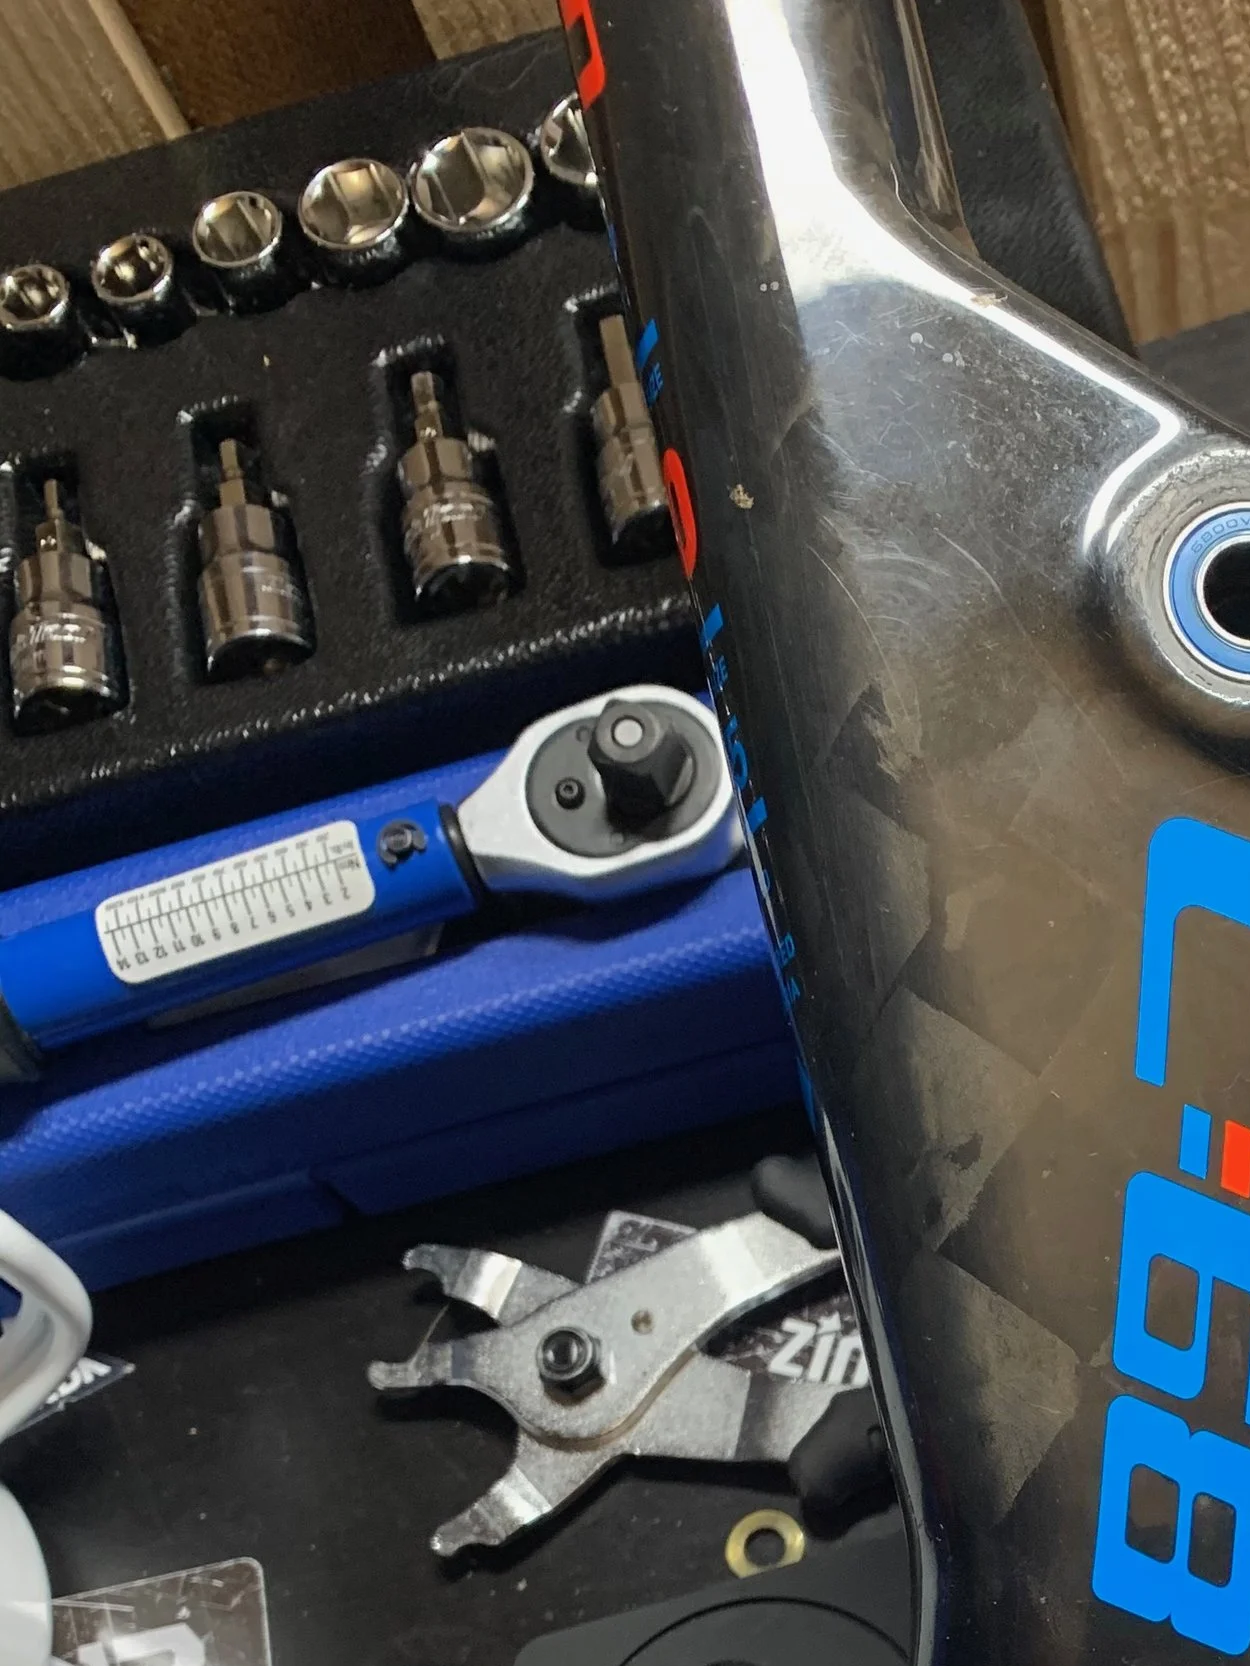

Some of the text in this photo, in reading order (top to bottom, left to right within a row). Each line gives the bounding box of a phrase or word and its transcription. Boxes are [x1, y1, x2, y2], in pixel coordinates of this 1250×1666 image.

[323, 892, 333, 906] 3
[340, 887, 351, 900] 2
[303, 900, 313, 912] 4
[249, 916, 260, 930] 7
[171, 940, 187, 954] 11
[190, 934, 206, 948] 10
[136, 952, 150, 966] 13
[154, 946, 169, 960] 12
[116, 958, 131, 972] 14
